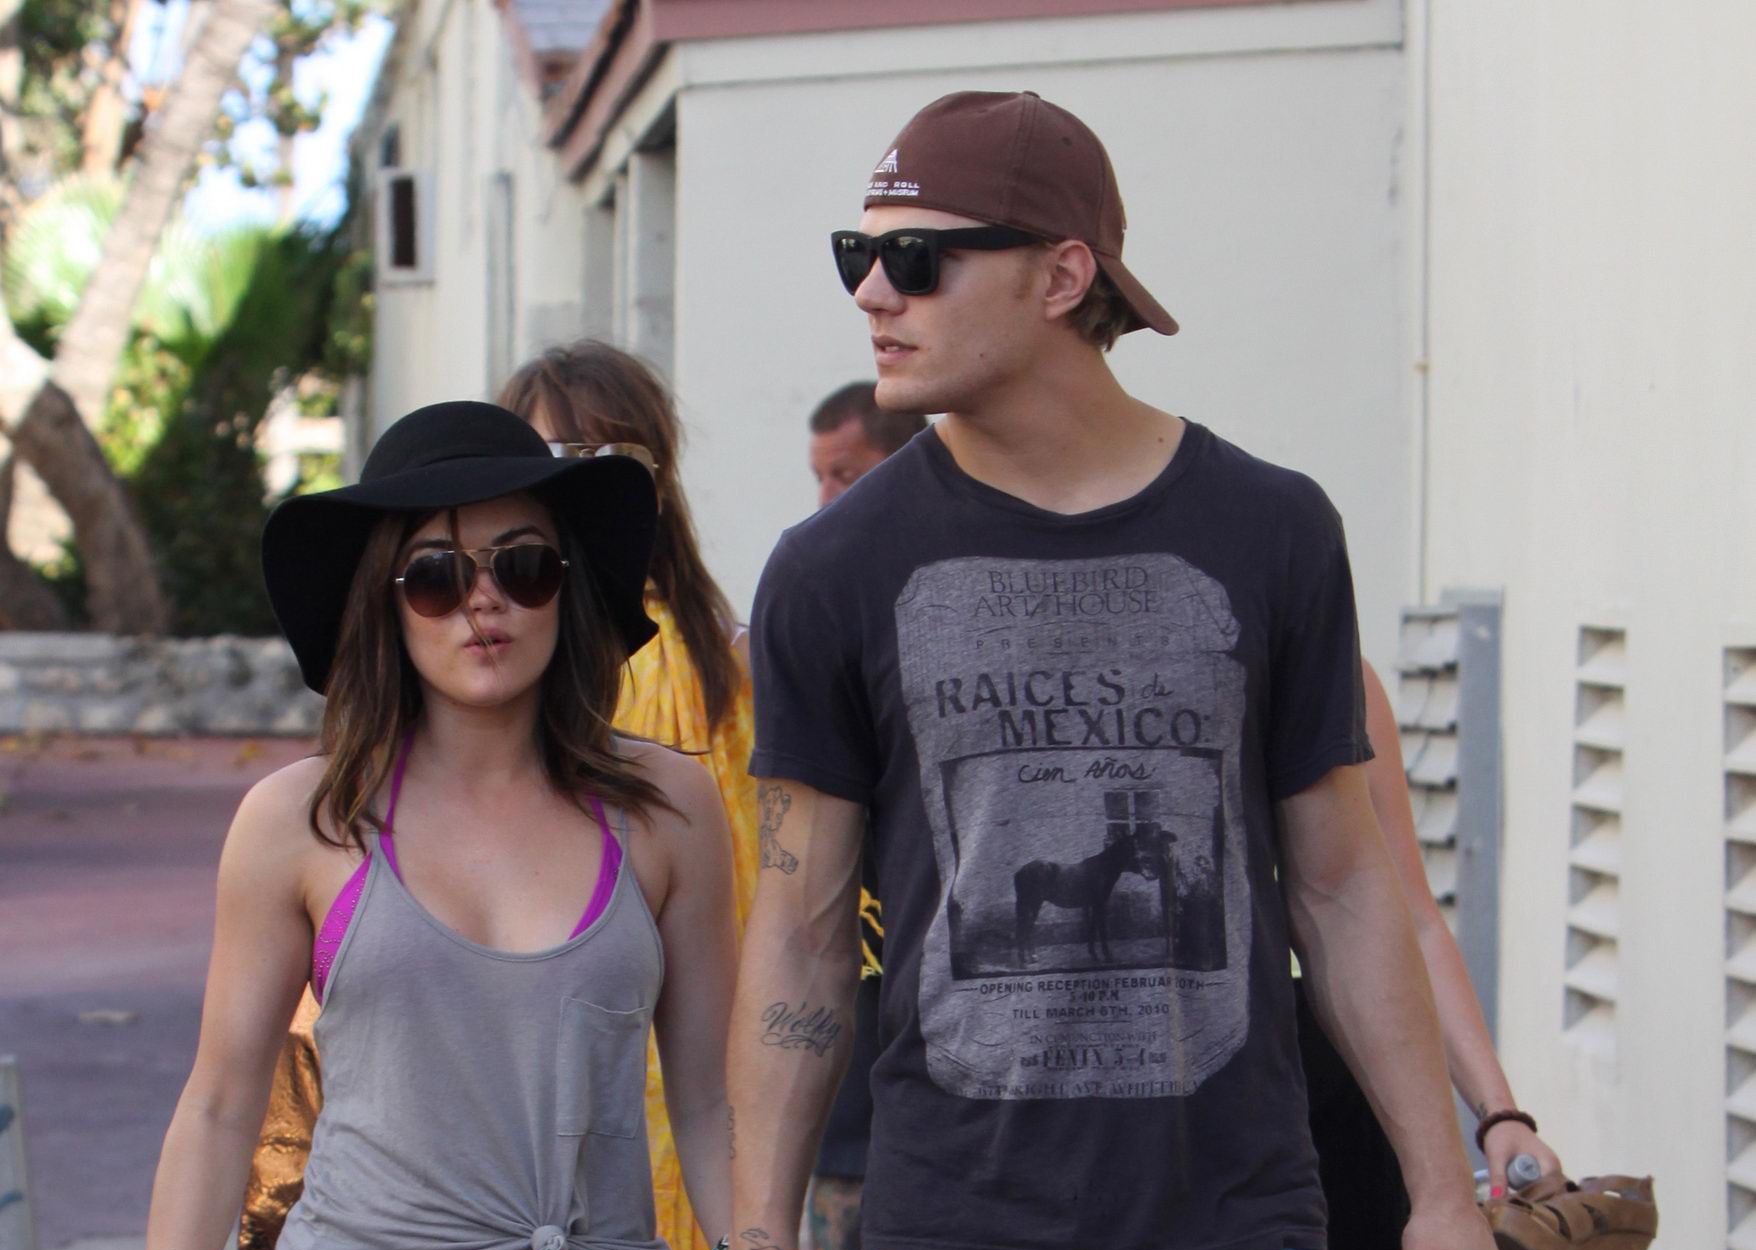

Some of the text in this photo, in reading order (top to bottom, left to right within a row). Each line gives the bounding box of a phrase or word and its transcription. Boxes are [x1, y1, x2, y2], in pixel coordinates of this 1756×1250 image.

[989, 566, 1149, 594] BLUEBIRD
[1055, 590, 1158, 617] HOUSE
[975, 635, 1171, 650] PRESENTS
[935, 669, 1126, 718] RAICES
[979, 981, 1033, 996] OPENING
[1012, 1007, 1040, 1019] TILL
[1046, 1006, 1095, 1018] MARCH
[1137, 1003, 1169, 1016] 2010
